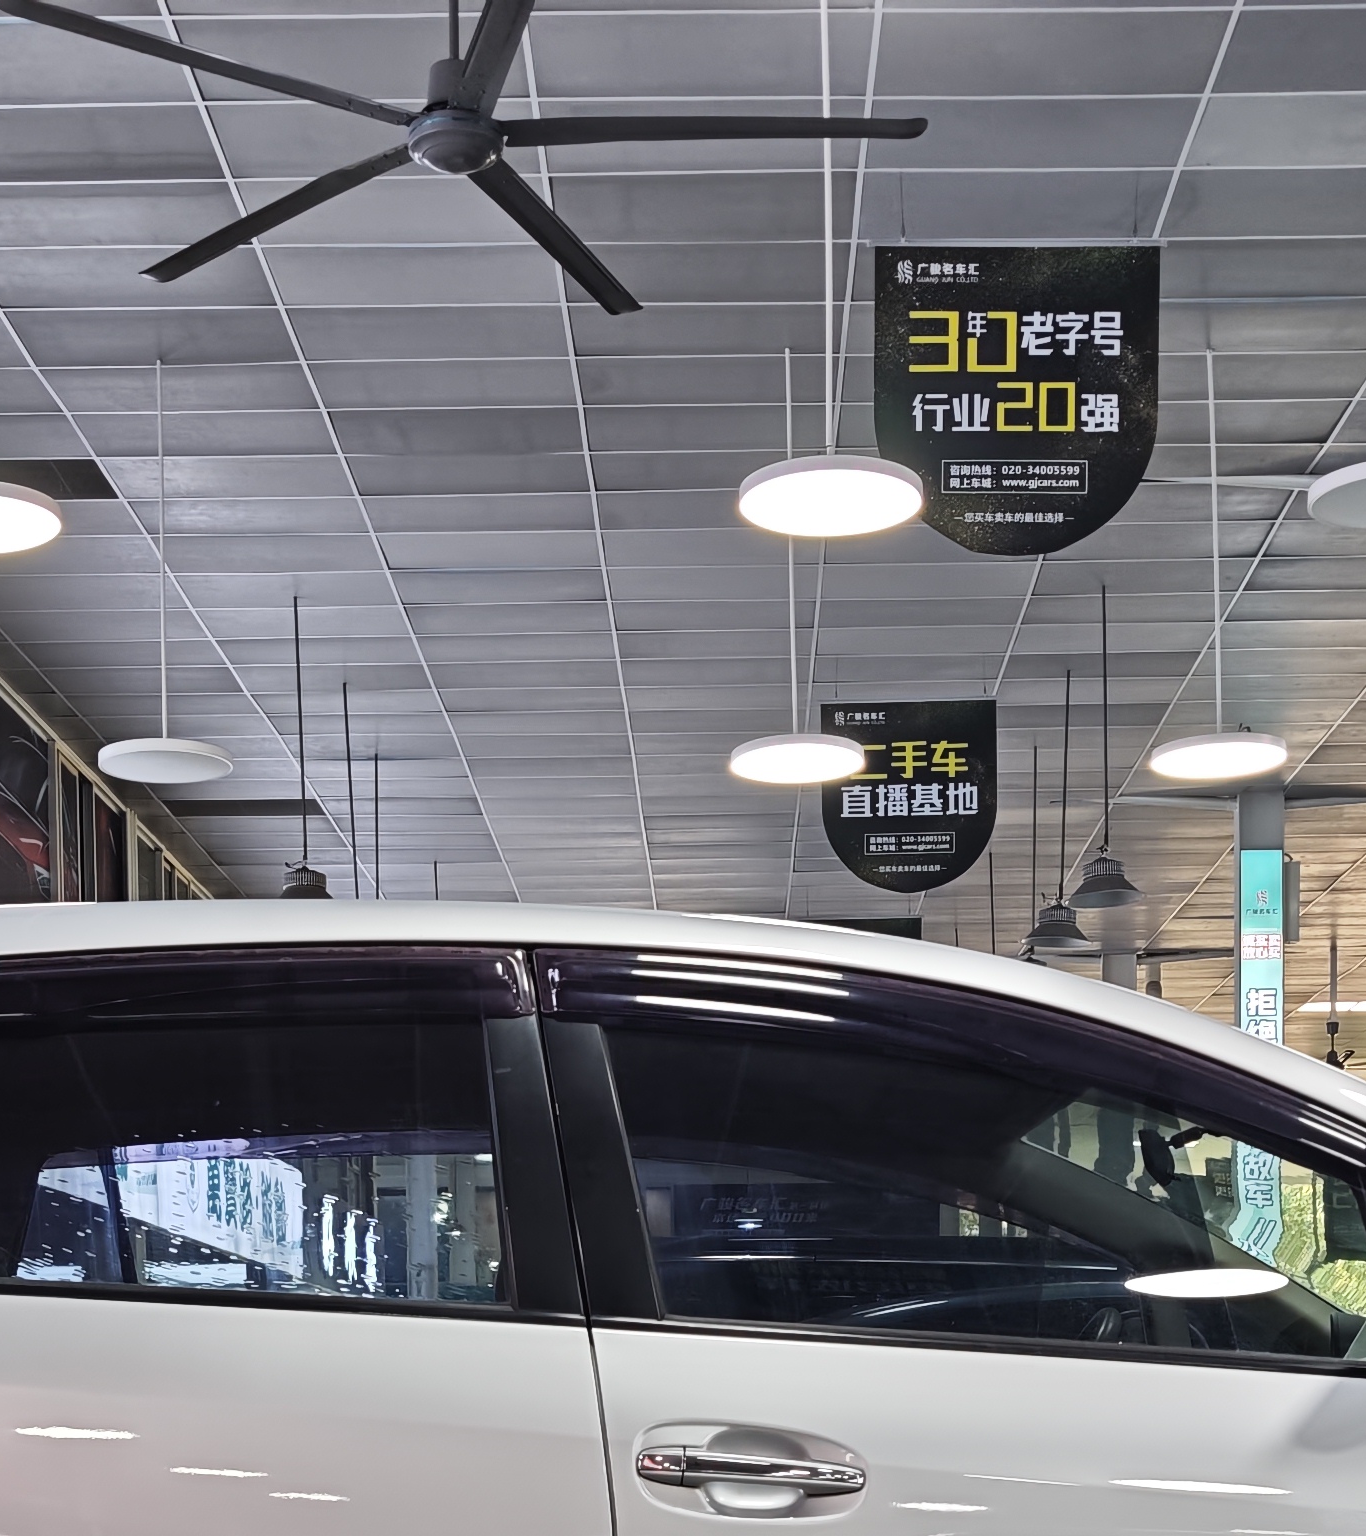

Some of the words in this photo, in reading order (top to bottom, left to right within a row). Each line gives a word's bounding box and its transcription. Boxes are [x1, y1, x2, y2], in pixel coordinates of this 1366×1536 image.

[912, 381, 1119, 433] 行业20强
[850, 740, 969, 779] 二手车
[841, 782, 979, 818] 直播基地
